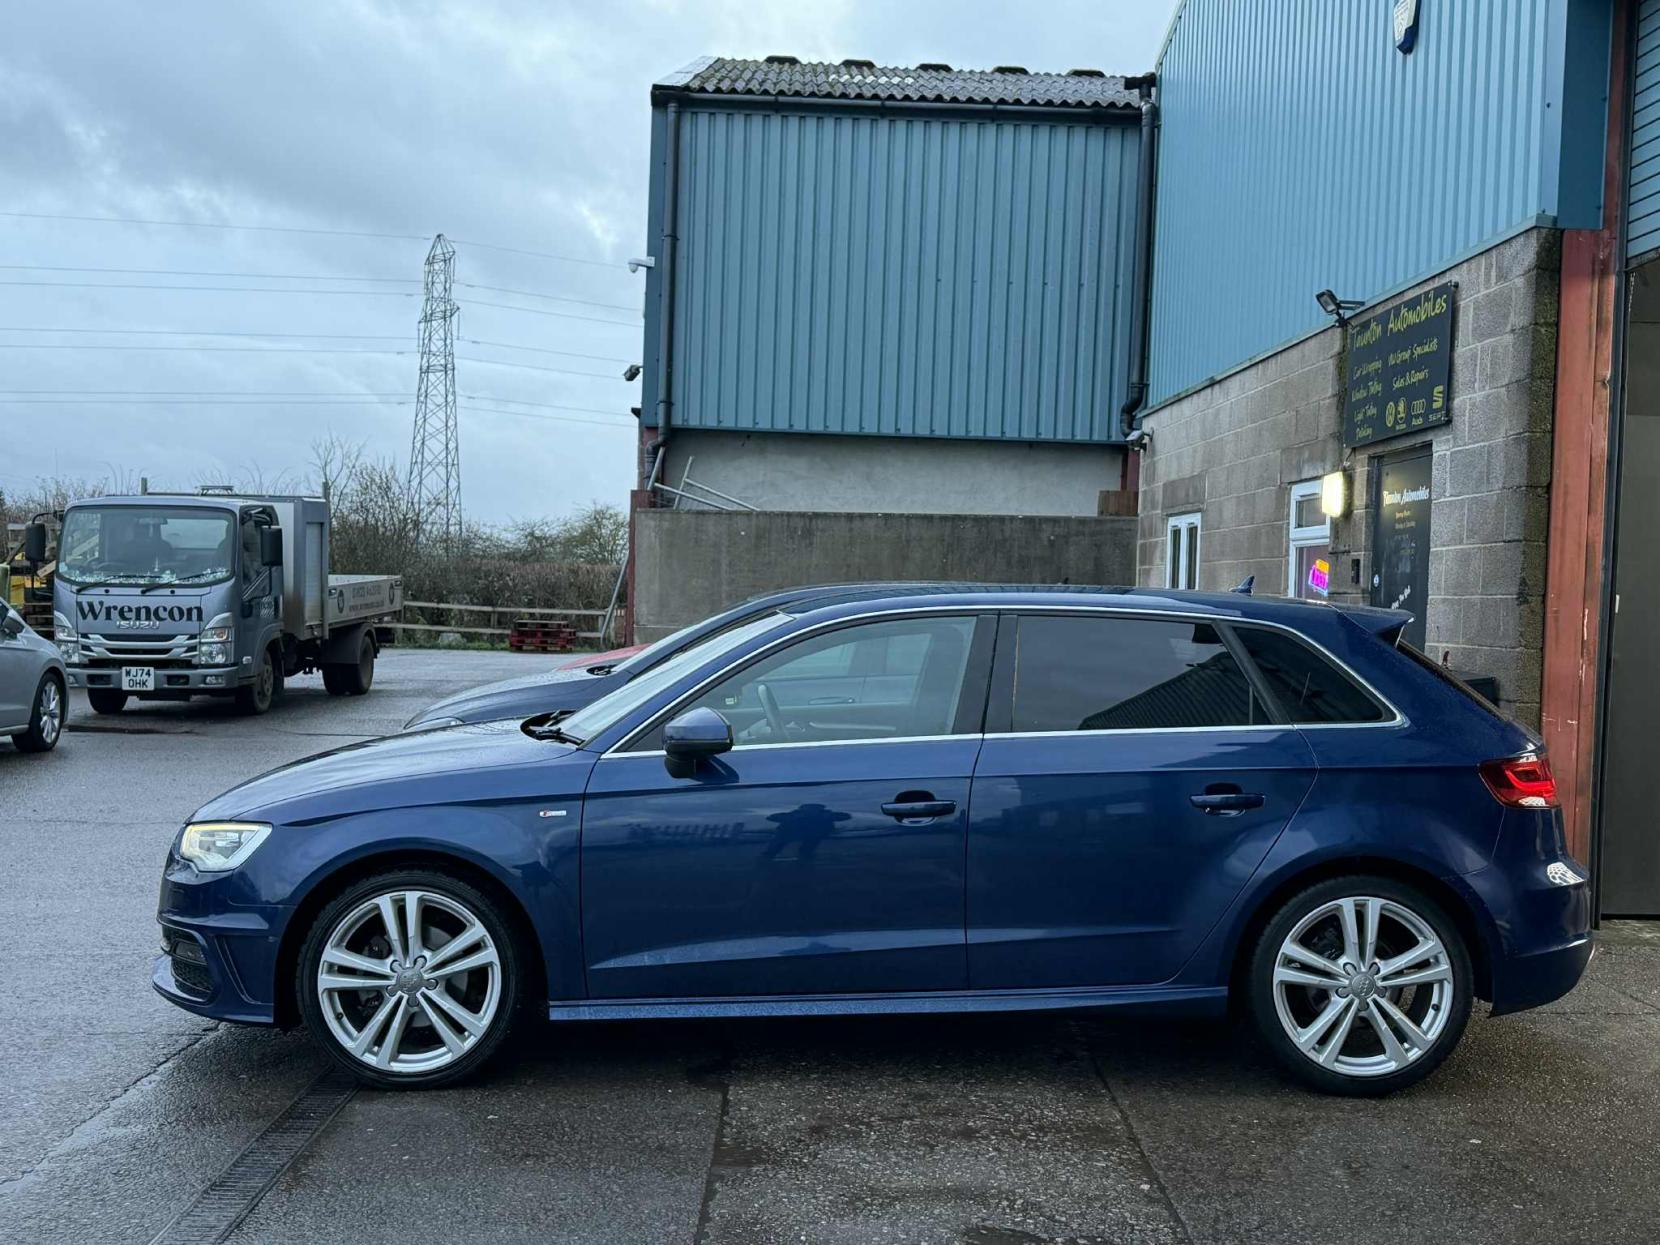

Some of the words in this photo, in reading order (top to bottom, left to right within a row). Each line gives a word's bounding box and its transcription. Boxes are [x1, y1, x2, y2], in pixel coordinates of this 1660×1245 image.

[1388, 290, 1447, 337] Automobiles
[76, 600, 203, 622] Wrencon
[116, 621, 160, 629] ISUZU
[125, 668, 151, 678] WJ74
[128, 679, 149, 688] OHK
